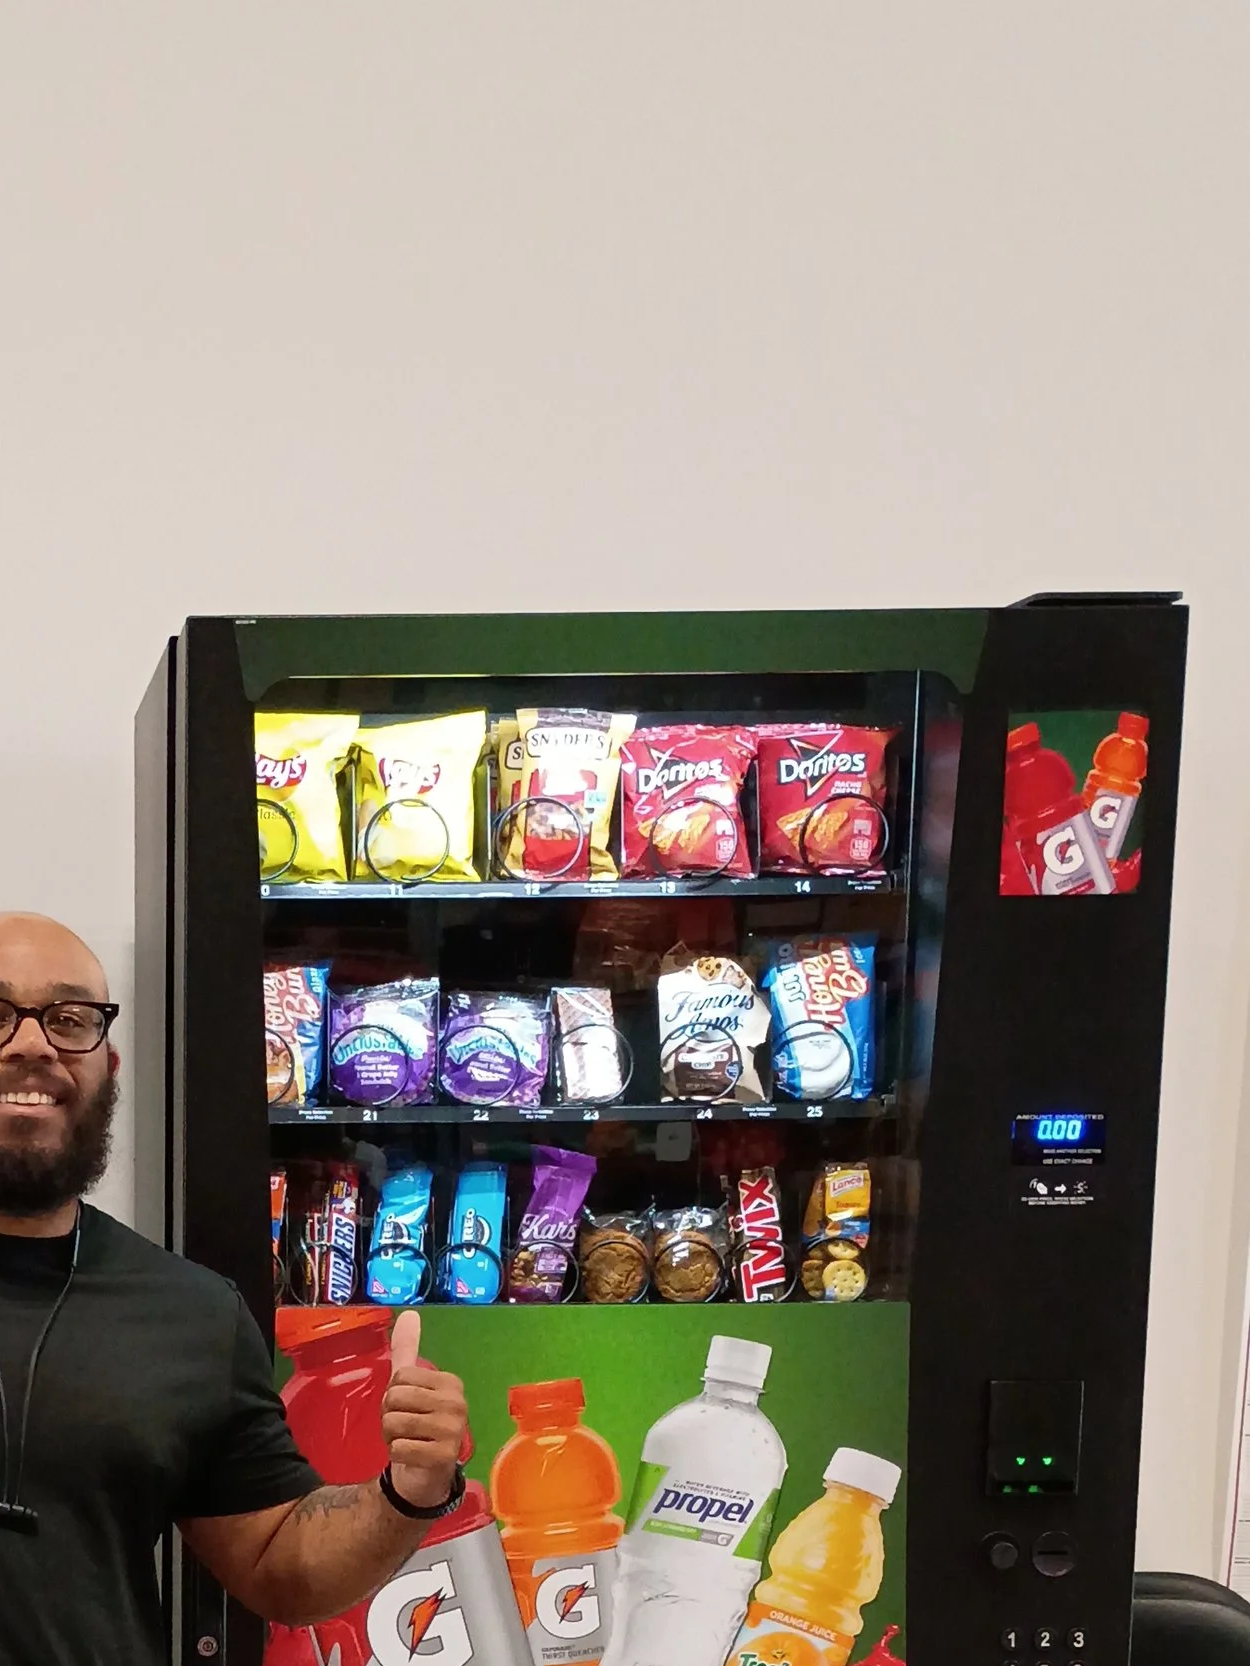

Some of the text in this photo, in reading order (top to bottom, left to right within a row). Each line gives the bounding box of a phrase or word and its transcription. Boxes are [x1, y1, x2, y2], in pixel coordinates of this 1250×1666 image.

[779, 752, 866, 785] Doritos
[1090, 796, 1121, 829] G
[1043, 826, 1085, 876] G
[794, 881, 811, 893] 14
[283, 967, 321, 1024] Bun
[665, 990, 755, 1022] Famous
[362, 1111, 378, 1121] 21
[473, 1110, 490, 1121] 22
[582, 1110, 600, 1121] 23
[696, 1109, 713, 1120] 24
[806, 1106, 823, 1118] 25
[831, 1174, 864, 1197] Lance
[521, 1212, 577, 1241] Kar's
[729, 1175, 786, 1303] TWIX
[652, 1487, 755, 1524] propel
[534, 1563, 602, 1639] G
[769, 1610, 838, 1641] ORANGE JUICE
[1007, 1631, 1084, 1648] 1 2 3
[542, 1652, 567, 1660] THIRST
